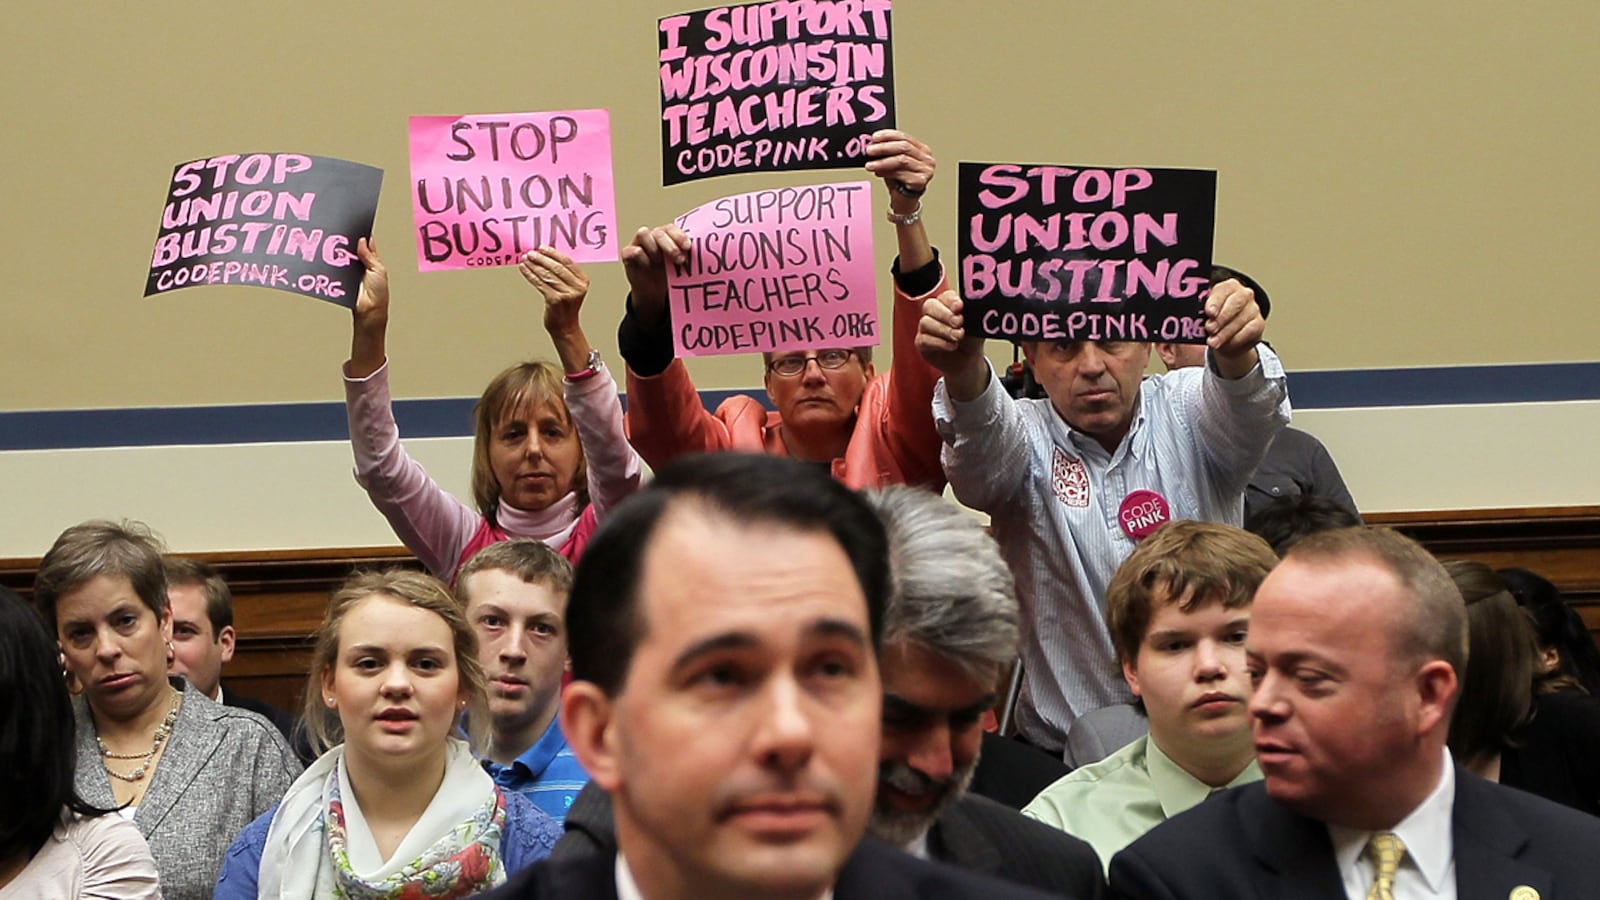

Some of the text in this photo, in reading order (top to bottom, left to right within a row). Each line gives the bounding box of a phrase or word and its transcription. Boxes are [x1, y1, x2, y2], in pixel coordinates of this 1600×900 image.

[658, 0, 892, 62] I SUPPORT
[660, 39, 885, 101] WISCONSIN
[663, 85, 887, 147] TEACHERS
[447, 116, 578, 164] STOP
[676, 133, 874, 175] CODEPINK.OR
[173, 153, 312, 197] STOP
[418, 172, 593, 214] UNION
[978, 164, 1153, 209] STOP
[163, 190, 316, 229] UNION
[713, 186, 863, 228] SUPPORT
[151, 222, 359, 268] BUSTING
[419, 211, 607, 263] BUSTING
[970, 211, 1178, 254] UNION
[156, 261, 346, 298] CODEPINK.ORG
[671, 268, 850, 314] TEACHERS
[962, 254, 1210, 304] BUSTING
[681, 312, 876, 350] CODEPINK.ORG
[982, 309, 1206, 340] CODEPINK.ORG
[1121, 497, 1162, 522] CODE
[1127, 509, 1165, 532] PINK
